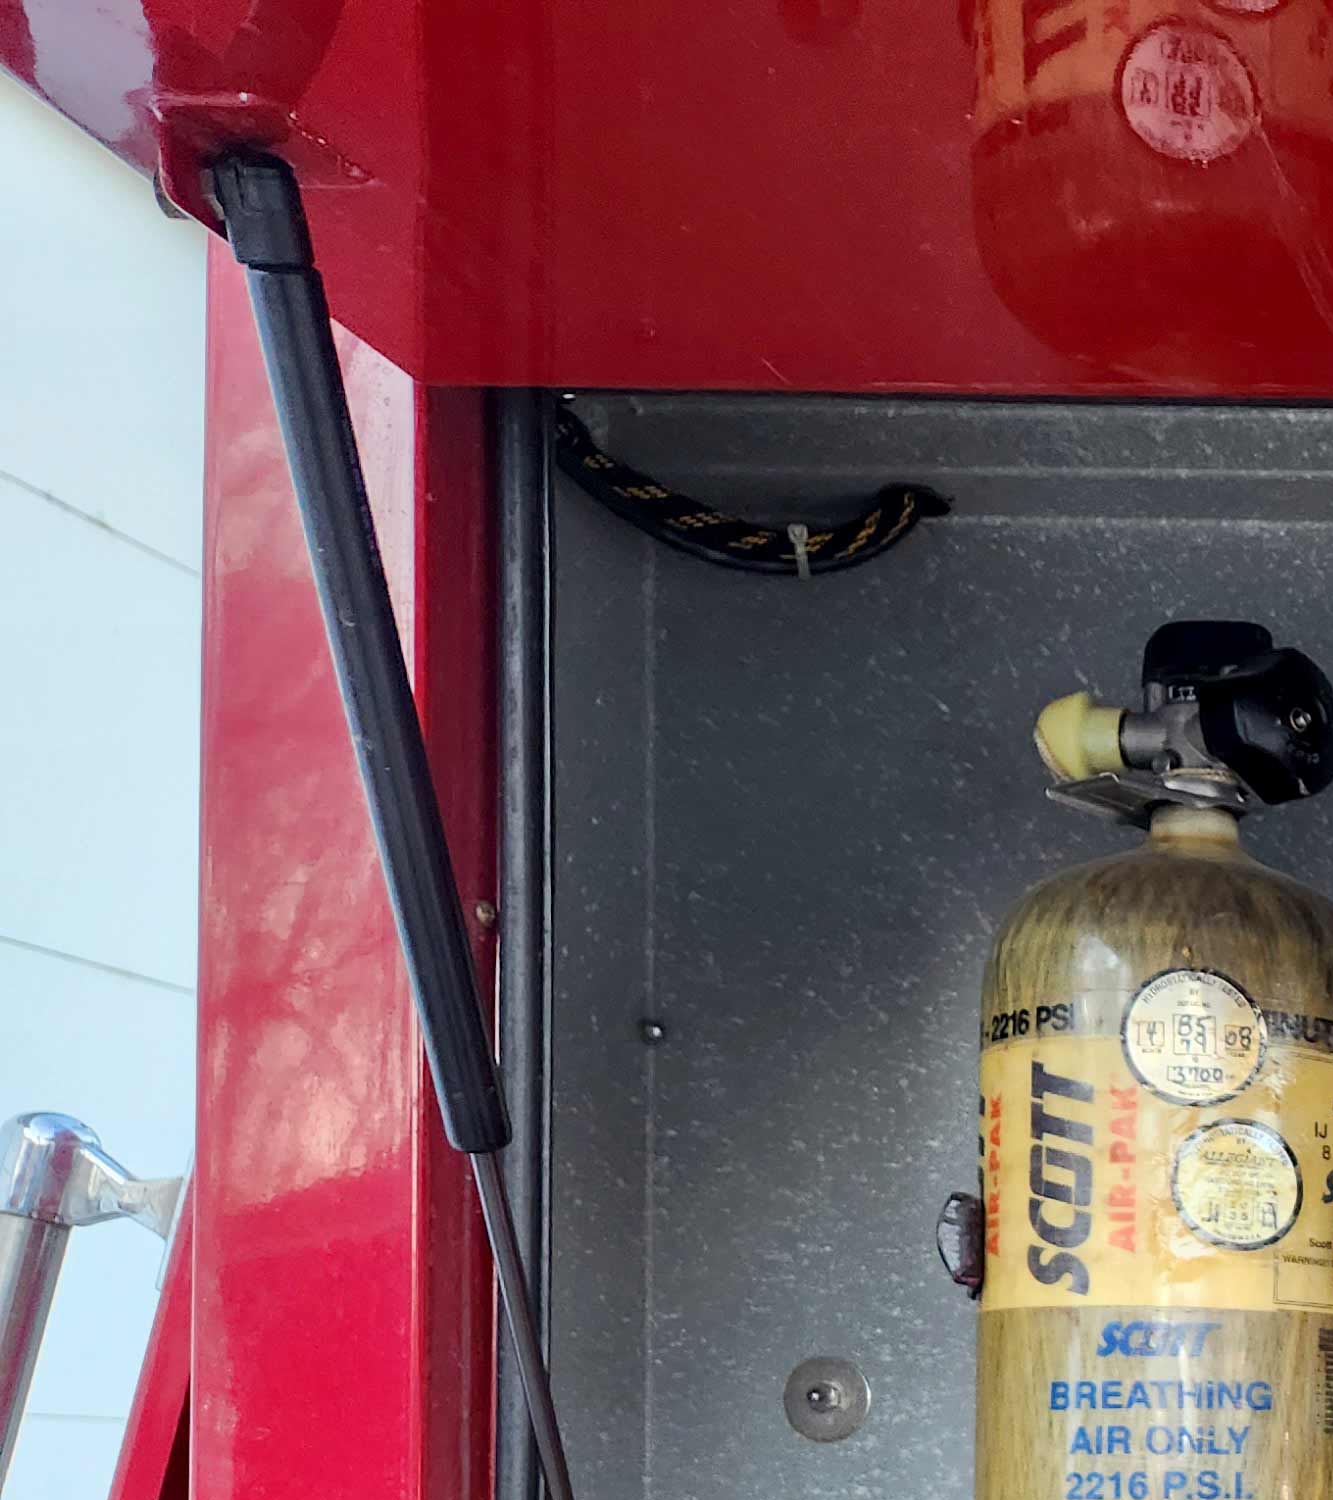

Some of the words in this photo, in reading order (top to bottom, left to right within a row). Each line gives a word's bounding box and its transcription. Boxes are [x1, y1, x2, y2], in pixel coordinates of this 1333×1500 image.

[1036, 1003, 1074, 1036] PSI
[1027, 1060, 1095, 1296] SCOTT
[1105, 1084, 1138, 1254] AIR-PAK
[1097, 1320, 1222, 1357] SCOTT
[1049, 1380, 1273, 1411] BREATHING
[1070, 1425, 1131, 1455] AIR
[1145, 1425, 1250, 1456] ONLY
[1065, 1470, 1149, 1500] 2216
[1163, 1470, 1253, 1500] P.S.I.
